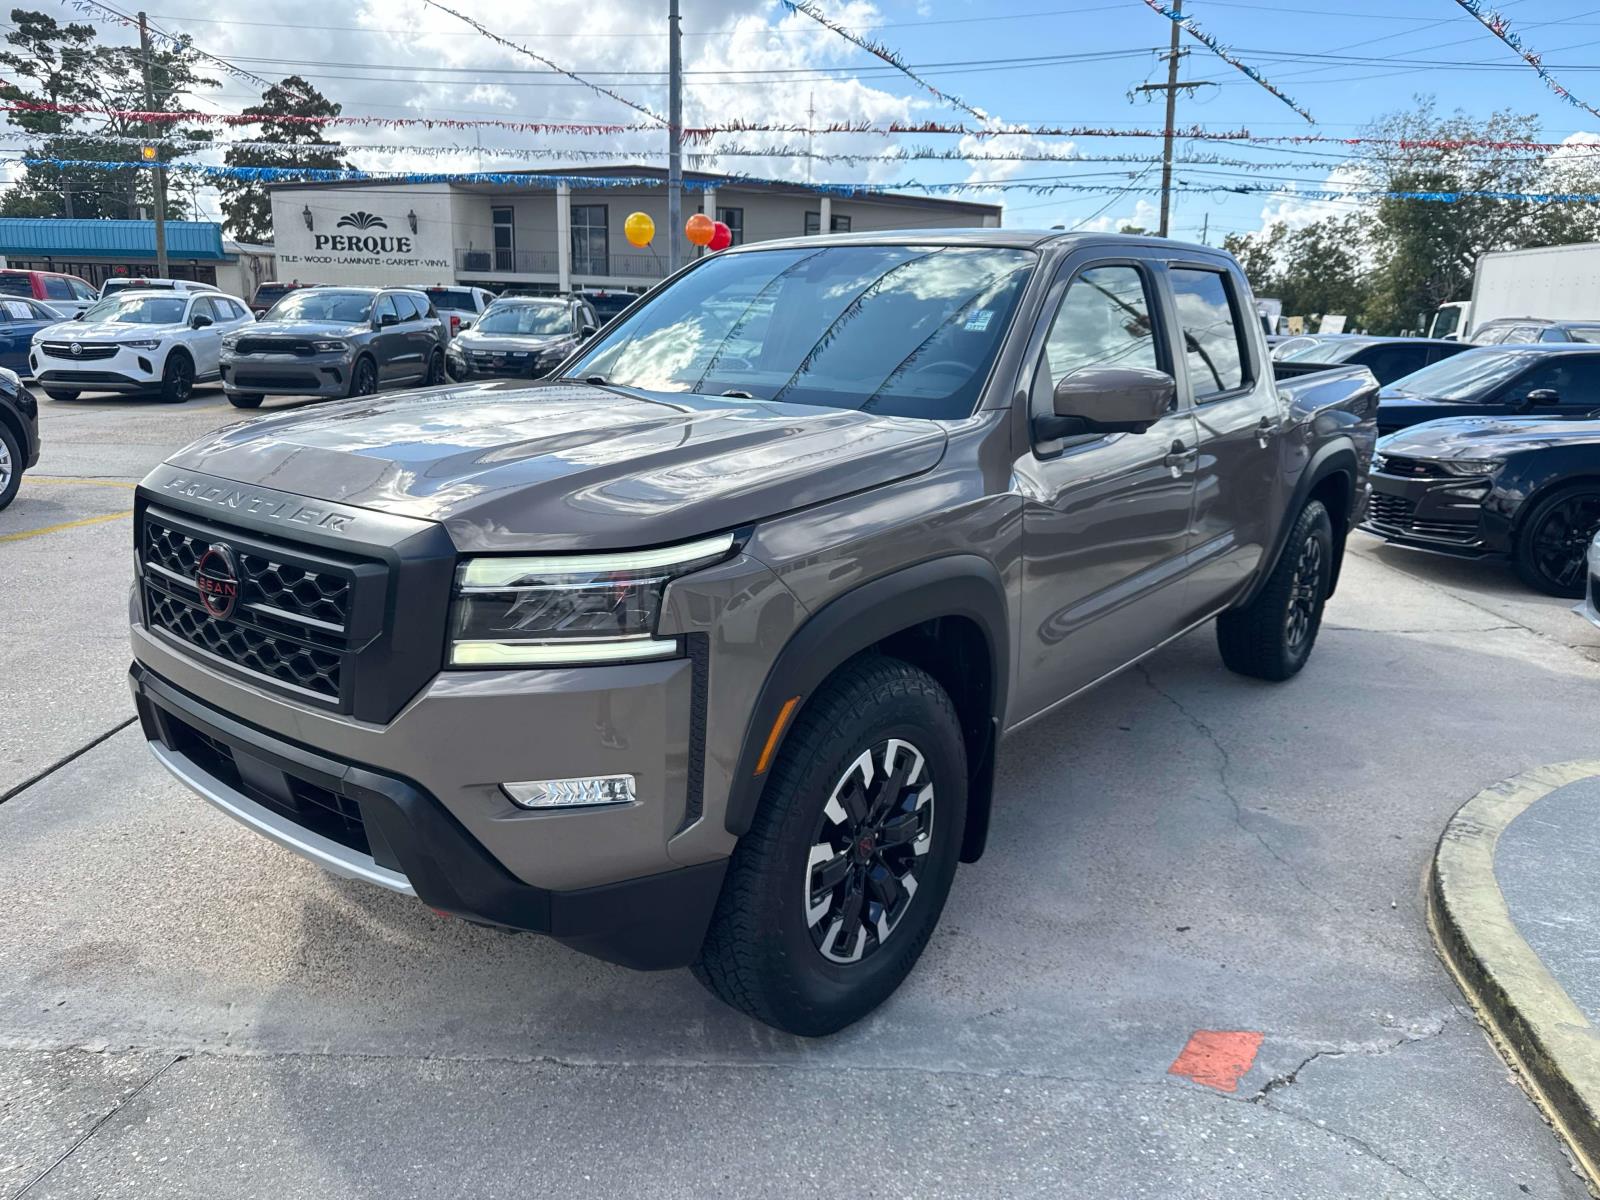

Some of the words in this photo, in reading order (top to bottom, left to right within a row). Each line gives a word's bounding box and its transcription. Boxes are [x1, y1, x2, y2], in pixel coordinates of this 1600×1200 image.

[314, 234, 412, 255] PERQUE
[280, 254, 298, 263] TILE
[304, 256, 332, 264] WOOD
[337, 257, 380, 265] LAMINATE
[386, 258, 420, 267] CARPET
[424, 260, 450, 268] VINYL
[163, 475, 355, 533] FRONTIER
[198, 576, 237, 597] SSAN
